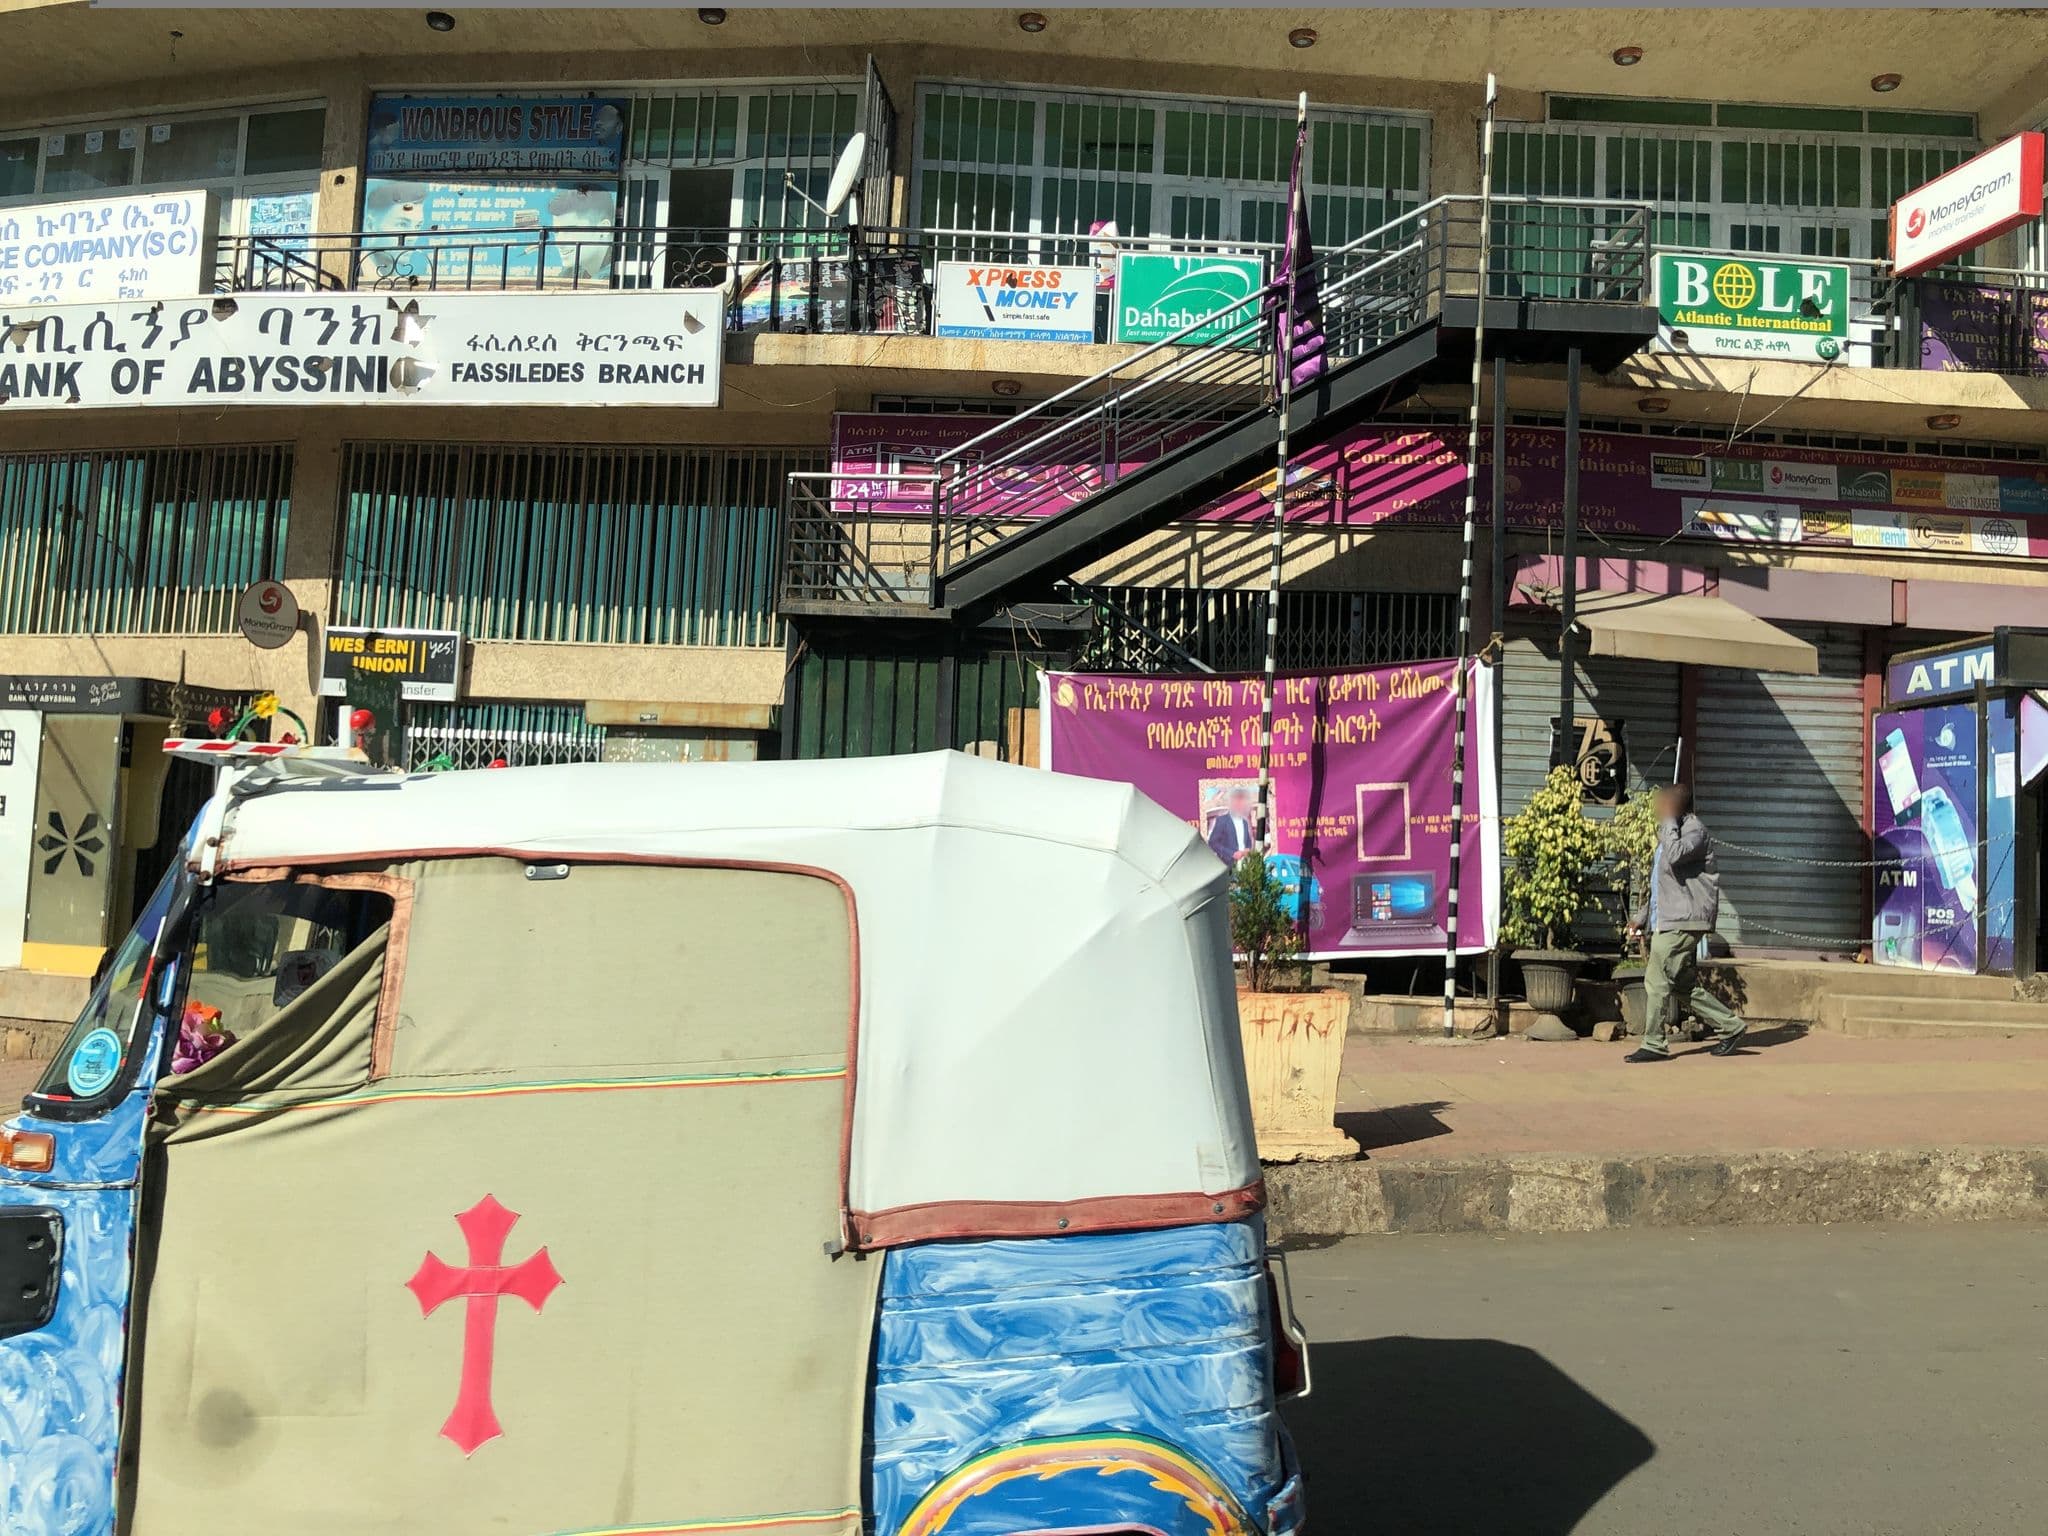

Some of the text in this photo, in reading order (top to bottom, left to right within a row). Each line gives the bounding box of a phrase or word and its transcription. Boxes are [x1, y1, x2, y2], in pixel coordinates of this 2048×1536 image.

[401, 104, 594, 142] WONDROUS STYLE
[1929, 172, 2012, 225] MoneyGram
[0, 247, 20, 269] E
[118, 286, 145, 300] Fax
[996, 290, 1079, 309] MONEY
[258, 304, 381, 346] ባንክ
[1674, 310, 1832, 332] Atlantic International
[576, 332, 683, 352] ቅርንጫፍ
[111, 357, 165, 395] OF
[187, 355, 394, 394] ABYSSINI
[451, 362, 705, 384] FASSILEDES BRANCH
[846, 482, 870, 498] 24
[1948, 495, 2001, 510] MONEY TRANSFER
[1916, 526, 1931, 539] TC
[244, 617, 293, 632] MoneyGram
[329, 637, 455, 659] WESERN yes!
[352, 656, 407, 673] UNION
[1907, 652, 1994, 694] ATM
[8, 694, 77, 703] BANK OF ABYSSINIA
[1084, 679, 1153, 712] የኢትዮጵያ
[1161, 682, 1196, 709] ንግድ
[1203, 680, 1233, 707] ባንክ
[1241, 712, 1304, 747] የሽማት
[1879, 870, 1917, 887] ATM
[1927, 907, 1955, 919] POS
